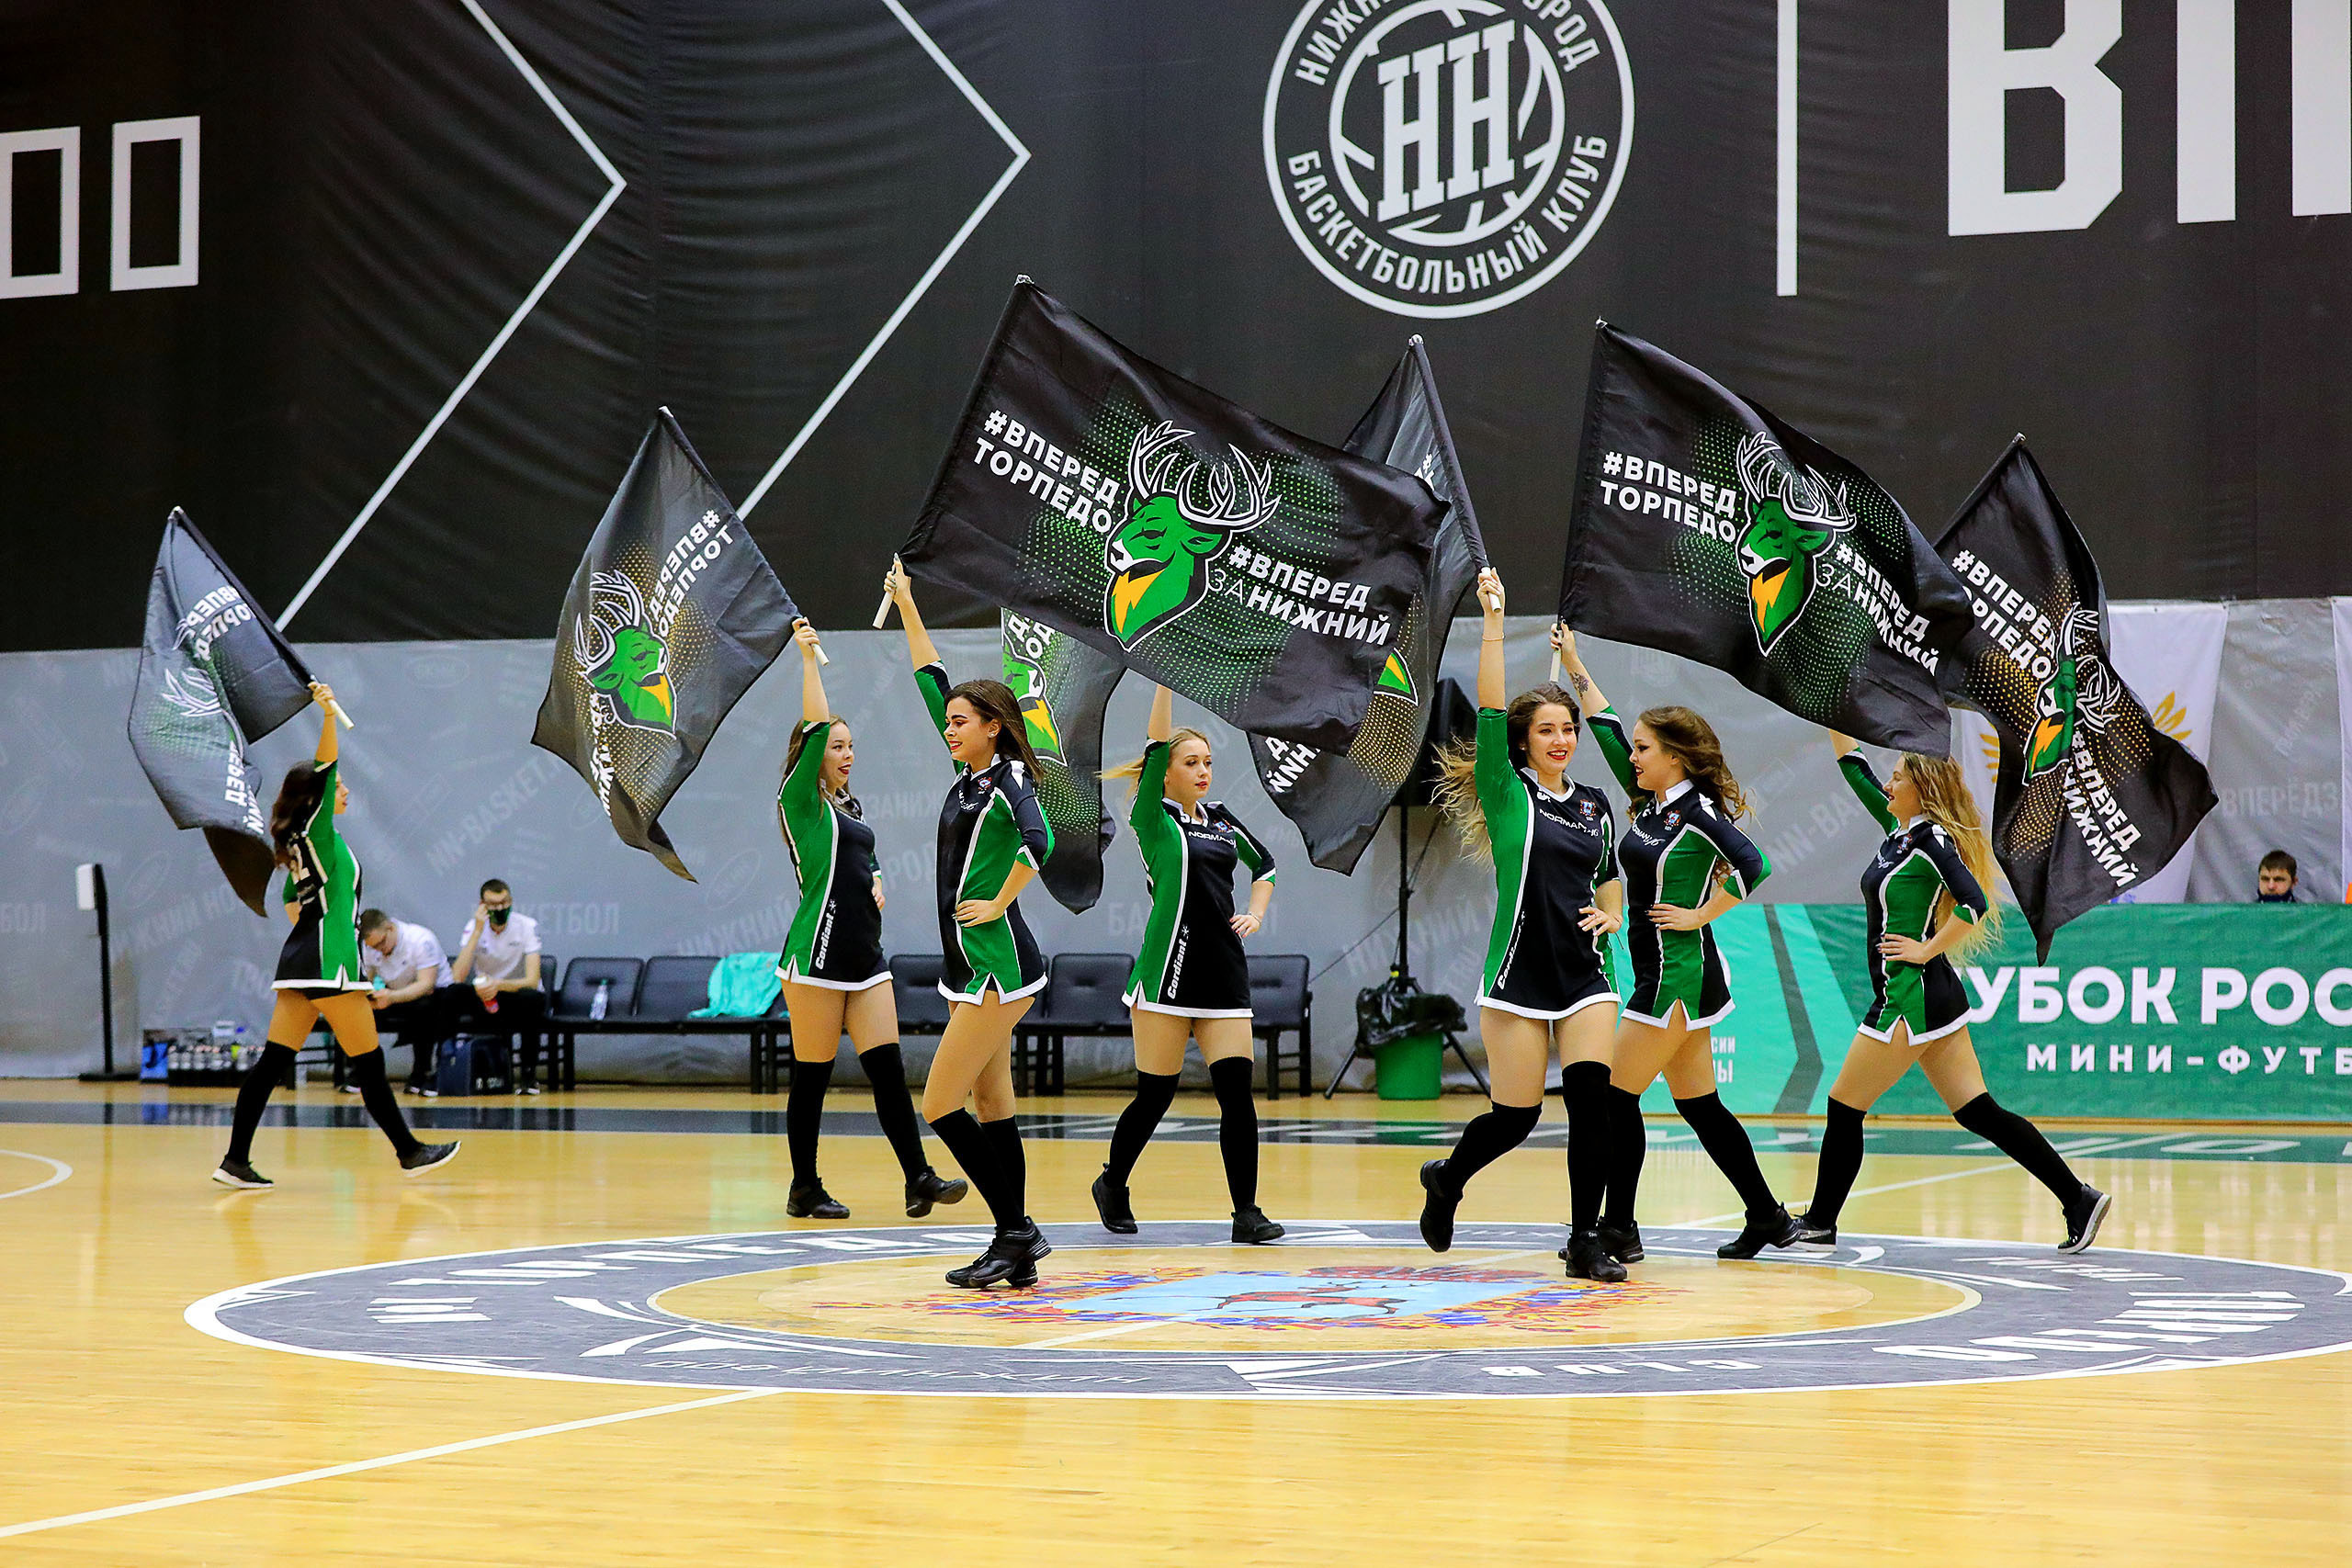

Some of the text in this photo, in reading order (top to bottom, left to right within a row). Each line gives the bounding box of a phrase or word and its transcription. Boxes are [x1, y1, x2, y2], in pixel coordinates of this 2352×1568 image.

[1288, 135, 1608, 294] БАСКЕТБОЛЬНЫЙ КЛУБ
[974, 436, 1113, 534] ТОРПЕДО
[983, 409, 1121, 510] #ВПЕРЕД
[1602, 451, 1736, 519] #ВПЕРЕД
[1600, 479, 1736, 544] ТОРПЕДО
[1228, 544, 1372, 613] #ВПЕРЕД
[1836, 541, 1930, 644] #ВПЕРЕД
[1962, 585, 2052, 680] РПЕДО
[815, 911, 835, 971] Cordiant
[1167, 938, 1187, 1000] Cordiant
[1955, 965, 2179, 1025] УБОК
[2026, 1044, 2352, 1075] МИНИ-ФУТБ
[1871, 1290, 2306, 1361] TORPEDO
[1479, 1359, 1764, 1377] CLUB
